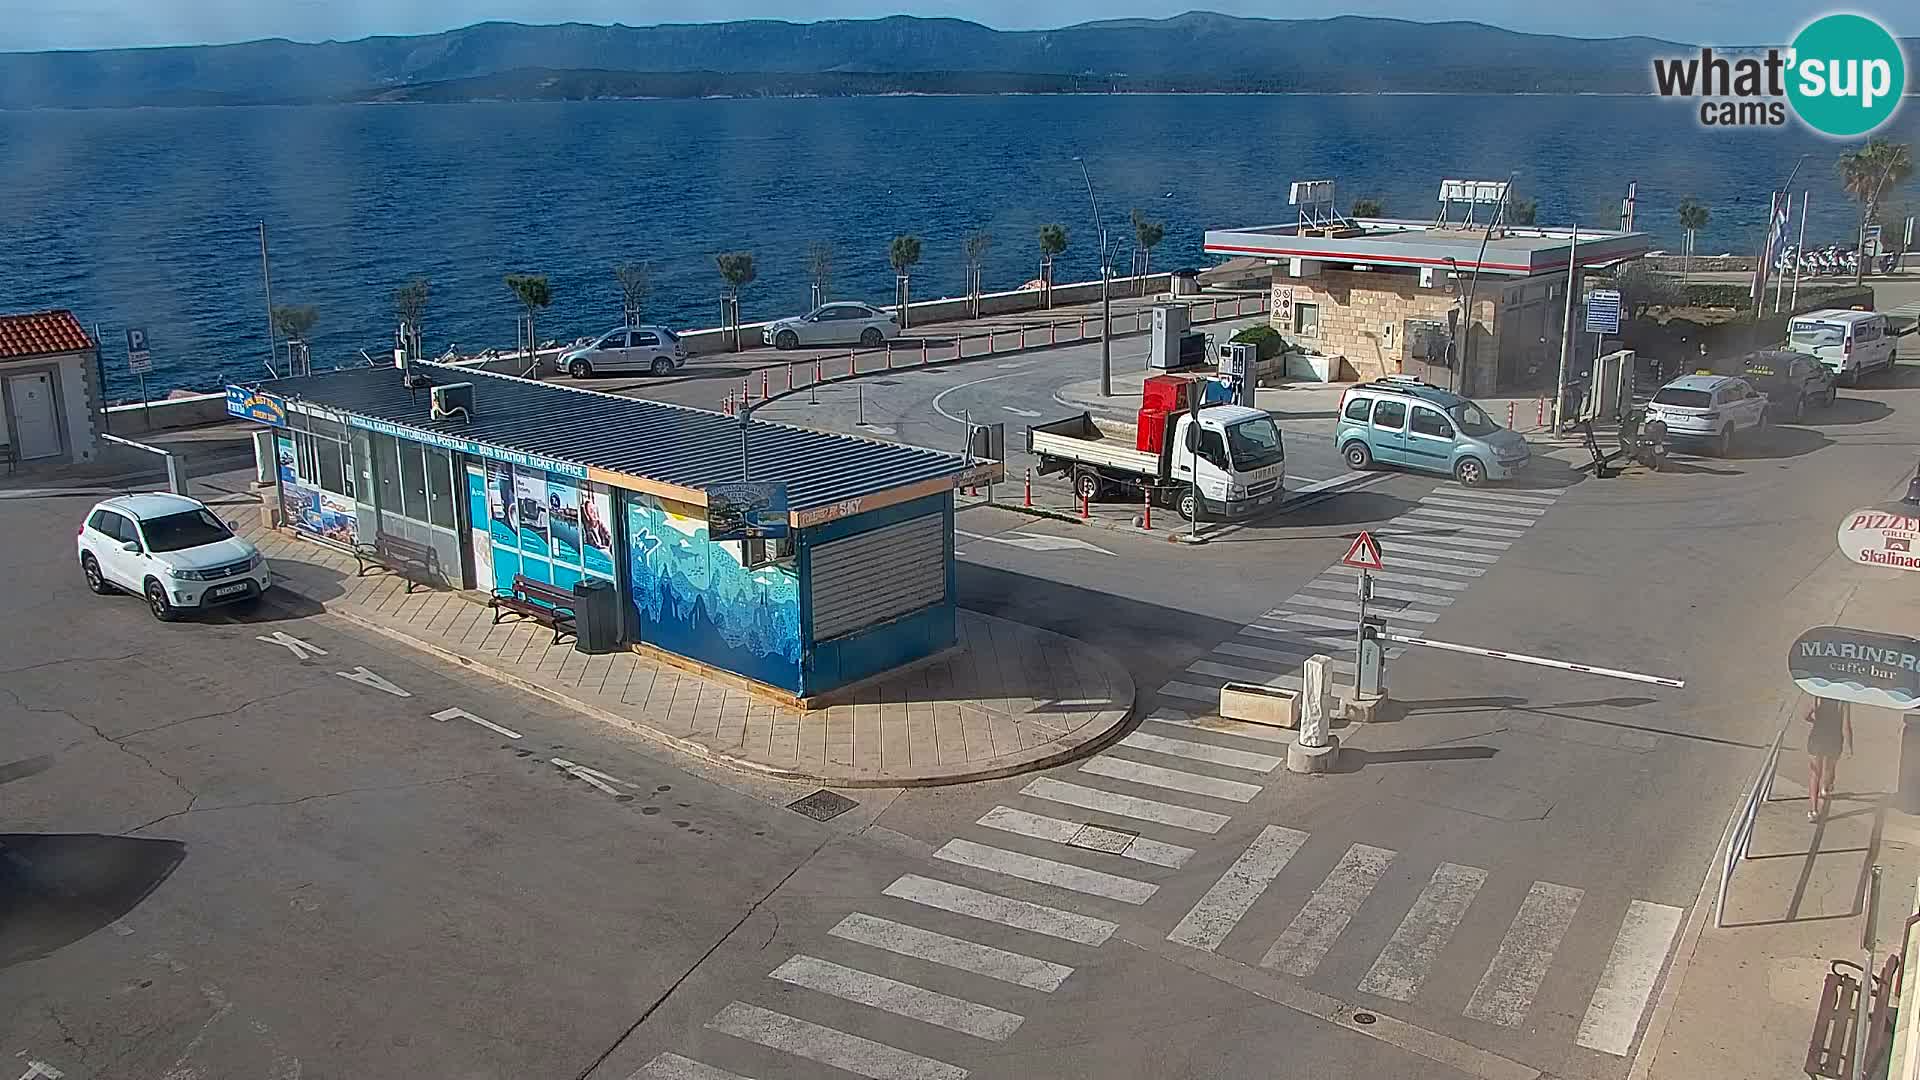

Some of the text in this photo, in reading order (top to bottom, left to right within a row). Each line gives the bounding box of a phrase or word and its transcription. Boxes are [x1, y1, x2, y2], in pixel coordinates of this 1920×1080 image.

[131, 330, 144, 349] P
[397, 426, 437, 443] AUTOBUSNA
[437, 435, 469, 451] POSTAJA
[479, 445, 494, 456] BUS
[495, 450, 527, 464] STATION
[529, 456, 555, 470] TICKET
[555, 463, 583, 477] OFFICE
[1882, 530, 1917, 540] GRILL
[1871, 664, 1896, 680] bar
